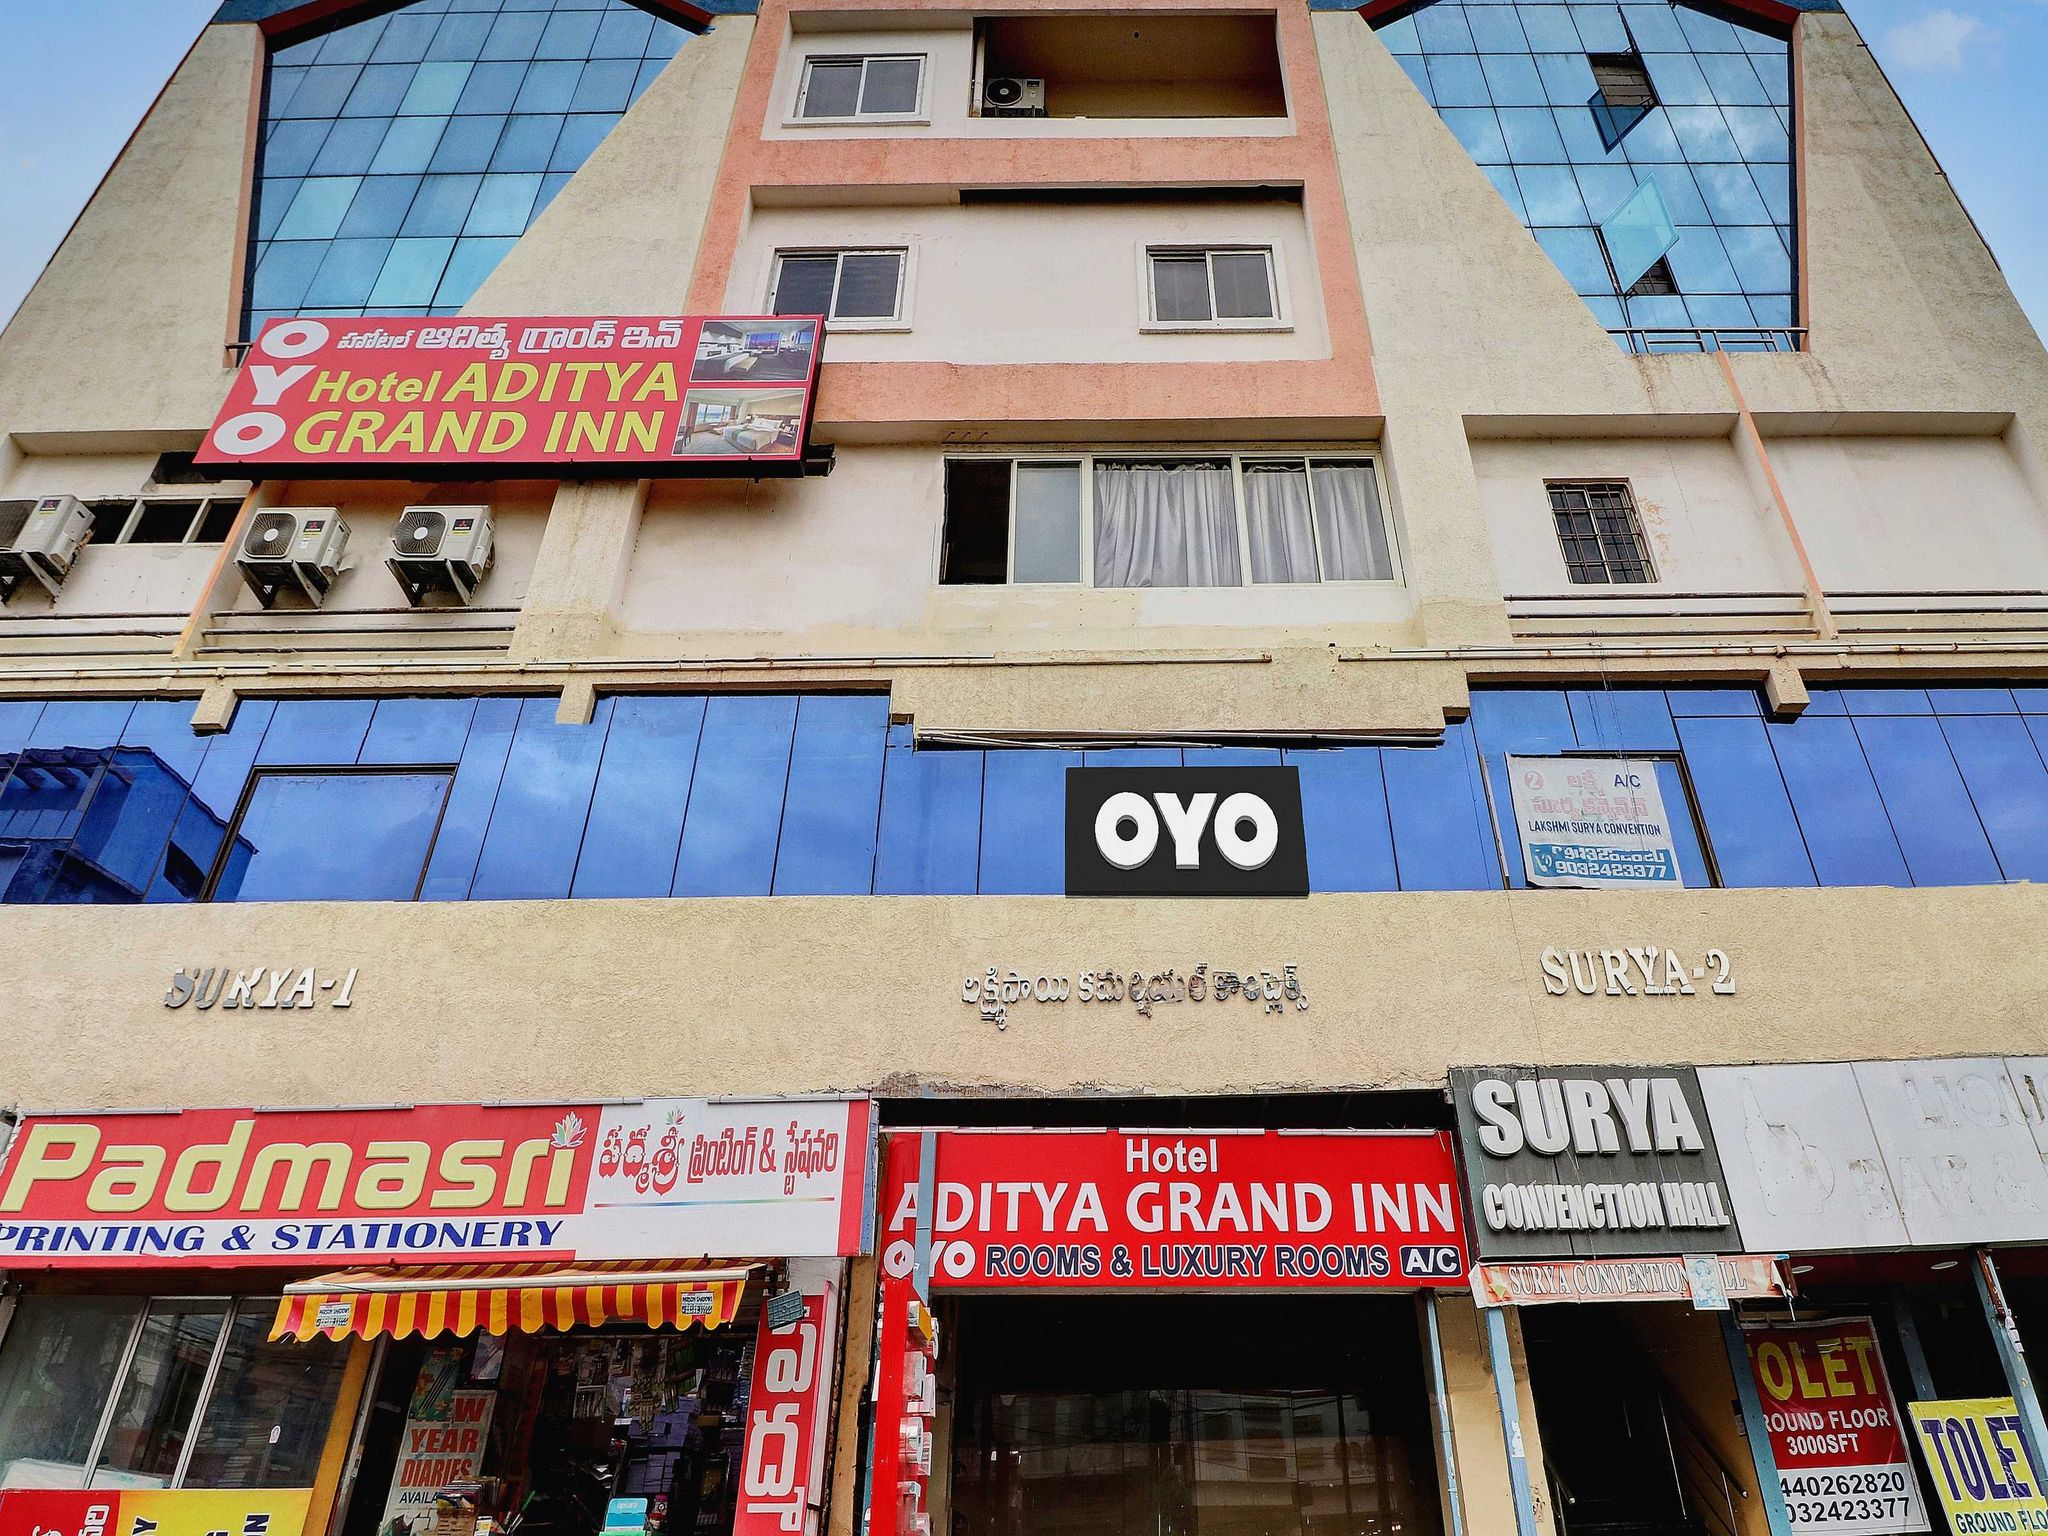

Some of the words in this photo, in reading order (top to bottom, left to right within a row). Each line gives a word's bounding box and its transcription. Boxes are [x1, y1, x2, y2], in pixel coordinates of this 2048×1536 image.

[415, 323, 512, 360] ఆదిత్య
[518, 320, 619, 354] గ్రాండ్
[620, 320, 684, 350] ఇన్
[213, 320, 330, 455] OYO
[308, 370, 439, 402] Hotel
[444, 363, 680, 402] ADITYA
[292, 410, 527, 454] GRAND
[543, 410, 666, 452] INN
[1614, 774, 1641, 788] A/C
[1095, 792, 1278, 870] OYO
[1528, 820, 1570, 832] LAKSHMI
[1571, 822, 1602, 834] SURYA
[1604, 823, 1662, 837] CONVENTION
[1555, 861, 1667, 878] 9032423377
[1540, 945, 1736, 995] SURYA-2
[1473, 1077, 1705, 1157] SURYA
[0, 1116, 580, 1213] Padmasri
[599, 1123, 684, 1196] పద్మశ్రీ
[759, 1127, 777, 1172] &
[1126, 1138, 1218, 1173] Hotel
[888, 1182, 1109, 1232] ADITYA
[1126, 1182, 1333, 1233] GRAND
[1353, 1182, 1456, 1233] INN
[1483, 1181, 1666, 1232] CONVENCTION
[1663, 1181, 1731, 1229] HALL
[0, 1222, 205, 1252] PRINTING
[222, 1223, 257, 1251] &
[271, 1220, 564, 1251] STATIONERY
[985, 1243, 1102, 1278] ROOMS
[1111, 1244, 1133, 1278] &
[1142, 1244, 1267, 1278] LUXURY
[1276, 1244, 1390, 1278] ROOMS
[1405, 1246, 1458, 1275] A/C
[1508, 1263, 1571, 1295] SURYA
[1573, 1261, 1689, 1295] CONVENTION
[1746, 1336, 1877, 1400] OLET
[1763, 1410, 1824, 1433] ROUND
[1828, 1408, 1891, 1430] FLOOR
[410, 1428, 481, 1453] YEAR
[1787, 1433, 1859, 1455] 3000SFT
[400, 1458, 473, 1488] DIARIES
[1780, 1472, 1905, 1498] 440262820
[399, 1491, 438, 1504] AVAILA
[1784, 1497, 1909, 1523] 032423377
[1955, 1511, 2018, 1534] GROUND
[2017, 1509, 2048, 1531] FLO
